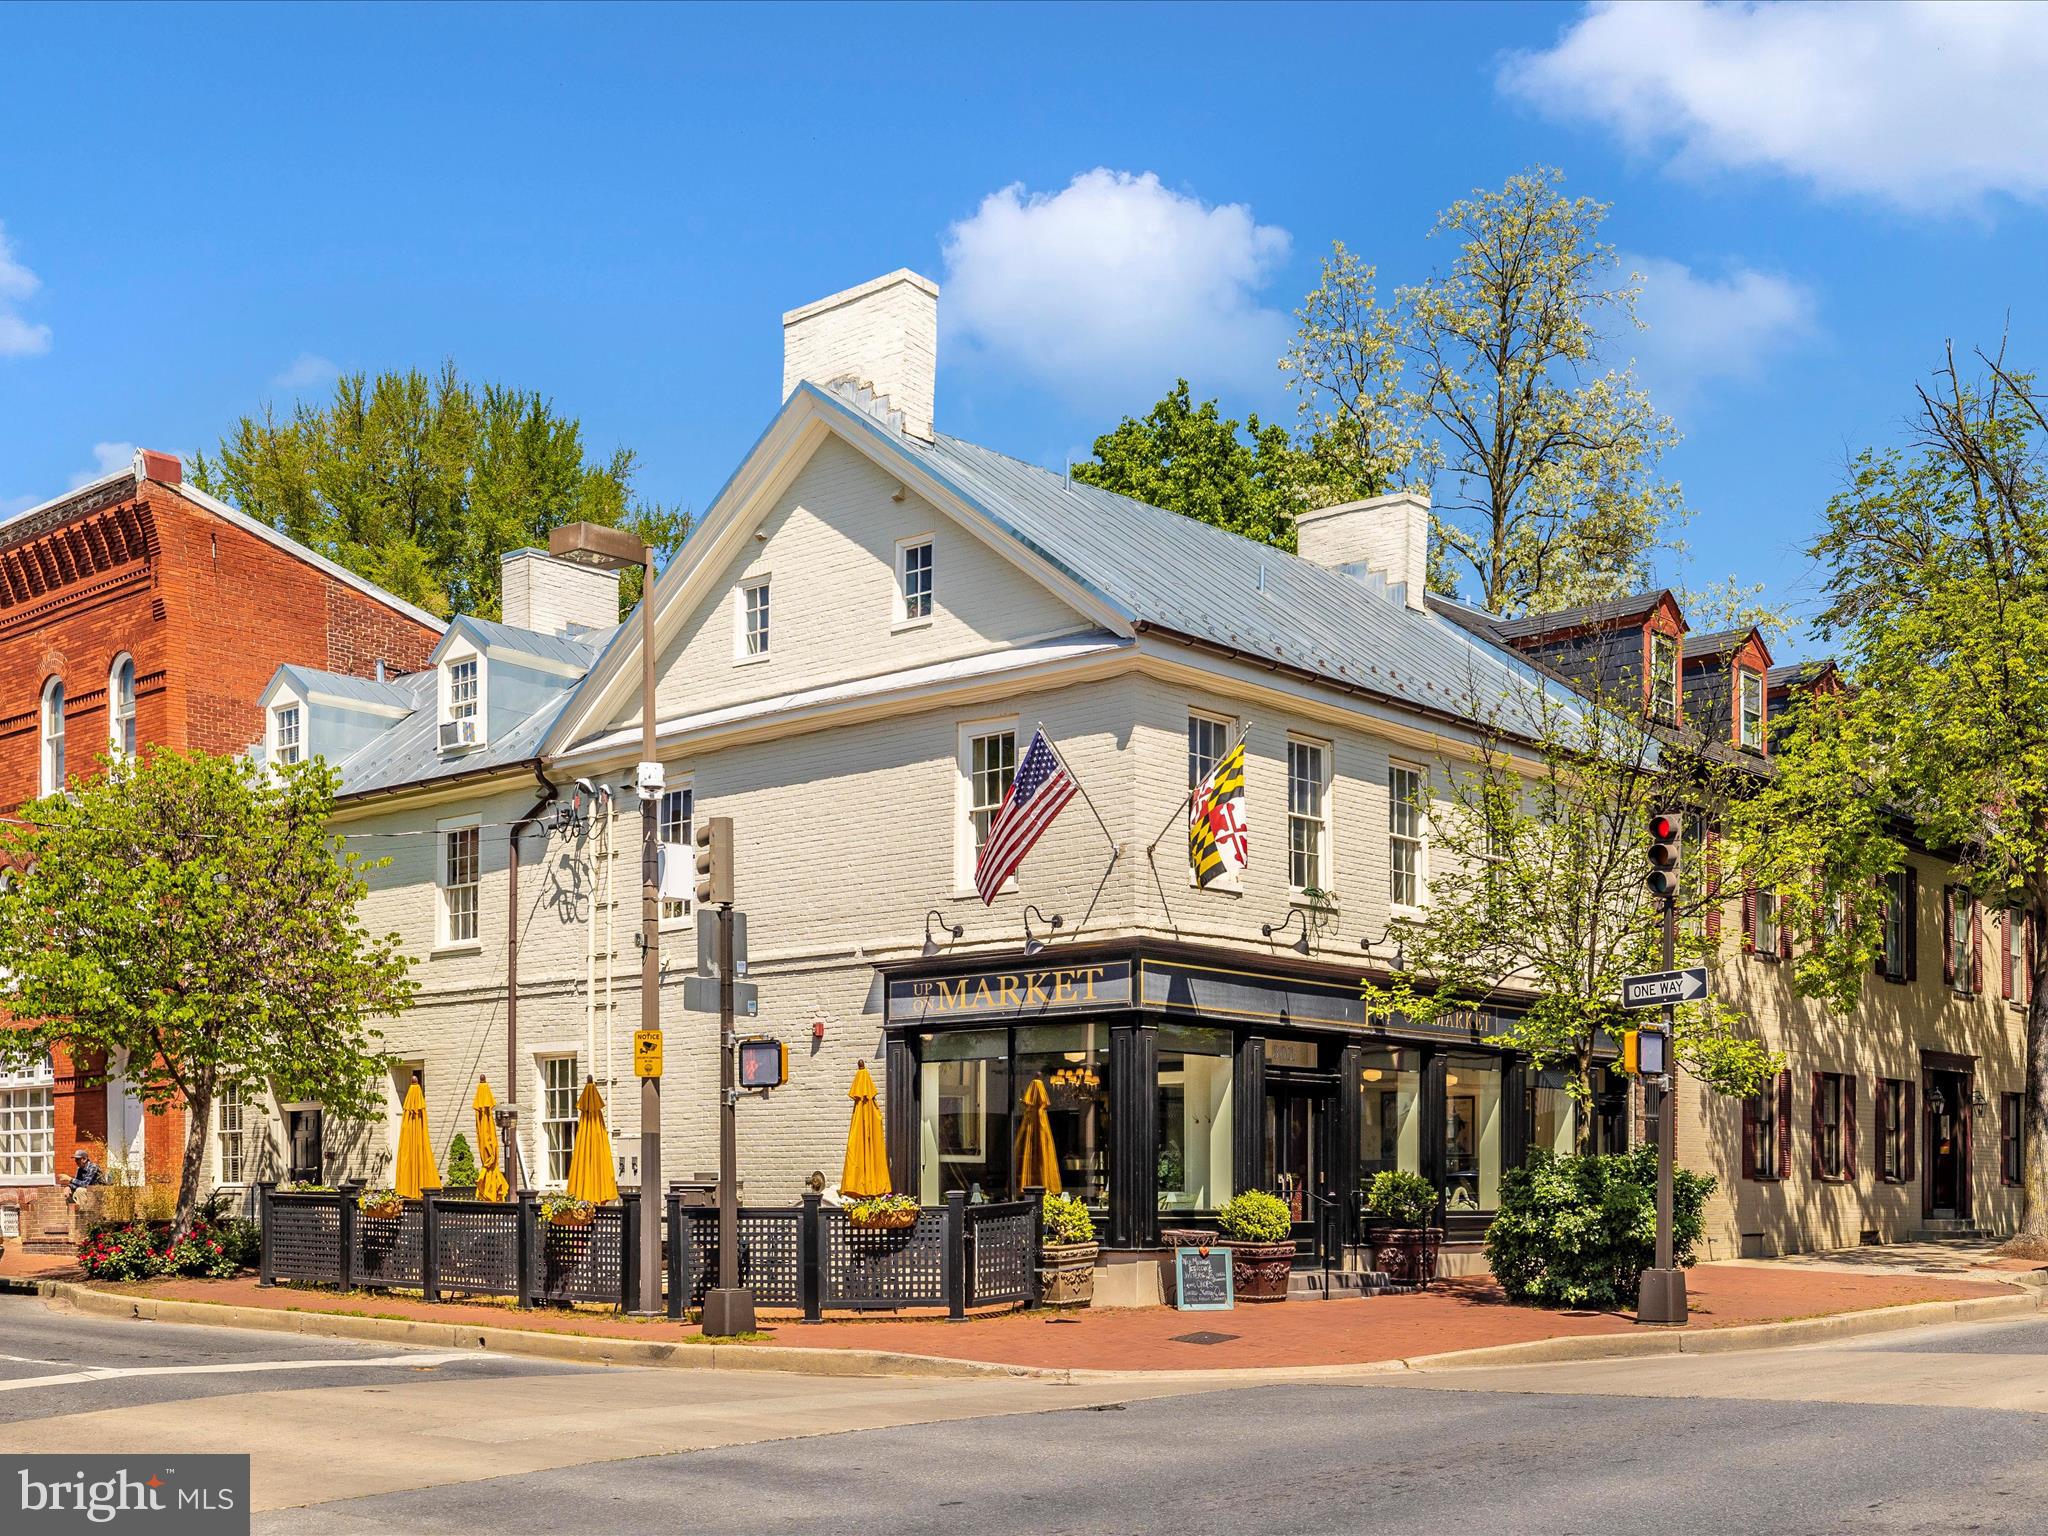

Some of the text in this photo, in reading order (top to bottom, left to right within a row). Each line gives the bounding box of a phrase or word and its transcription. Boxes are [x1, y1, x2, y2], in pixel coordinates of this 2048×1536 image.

[913, 983, 933, 997] UP
[936, 967, 1104, 1011] MARKET
[1634, 980, 1683, 998] ONE WAY
[912, 998, 934, 1012] ON
